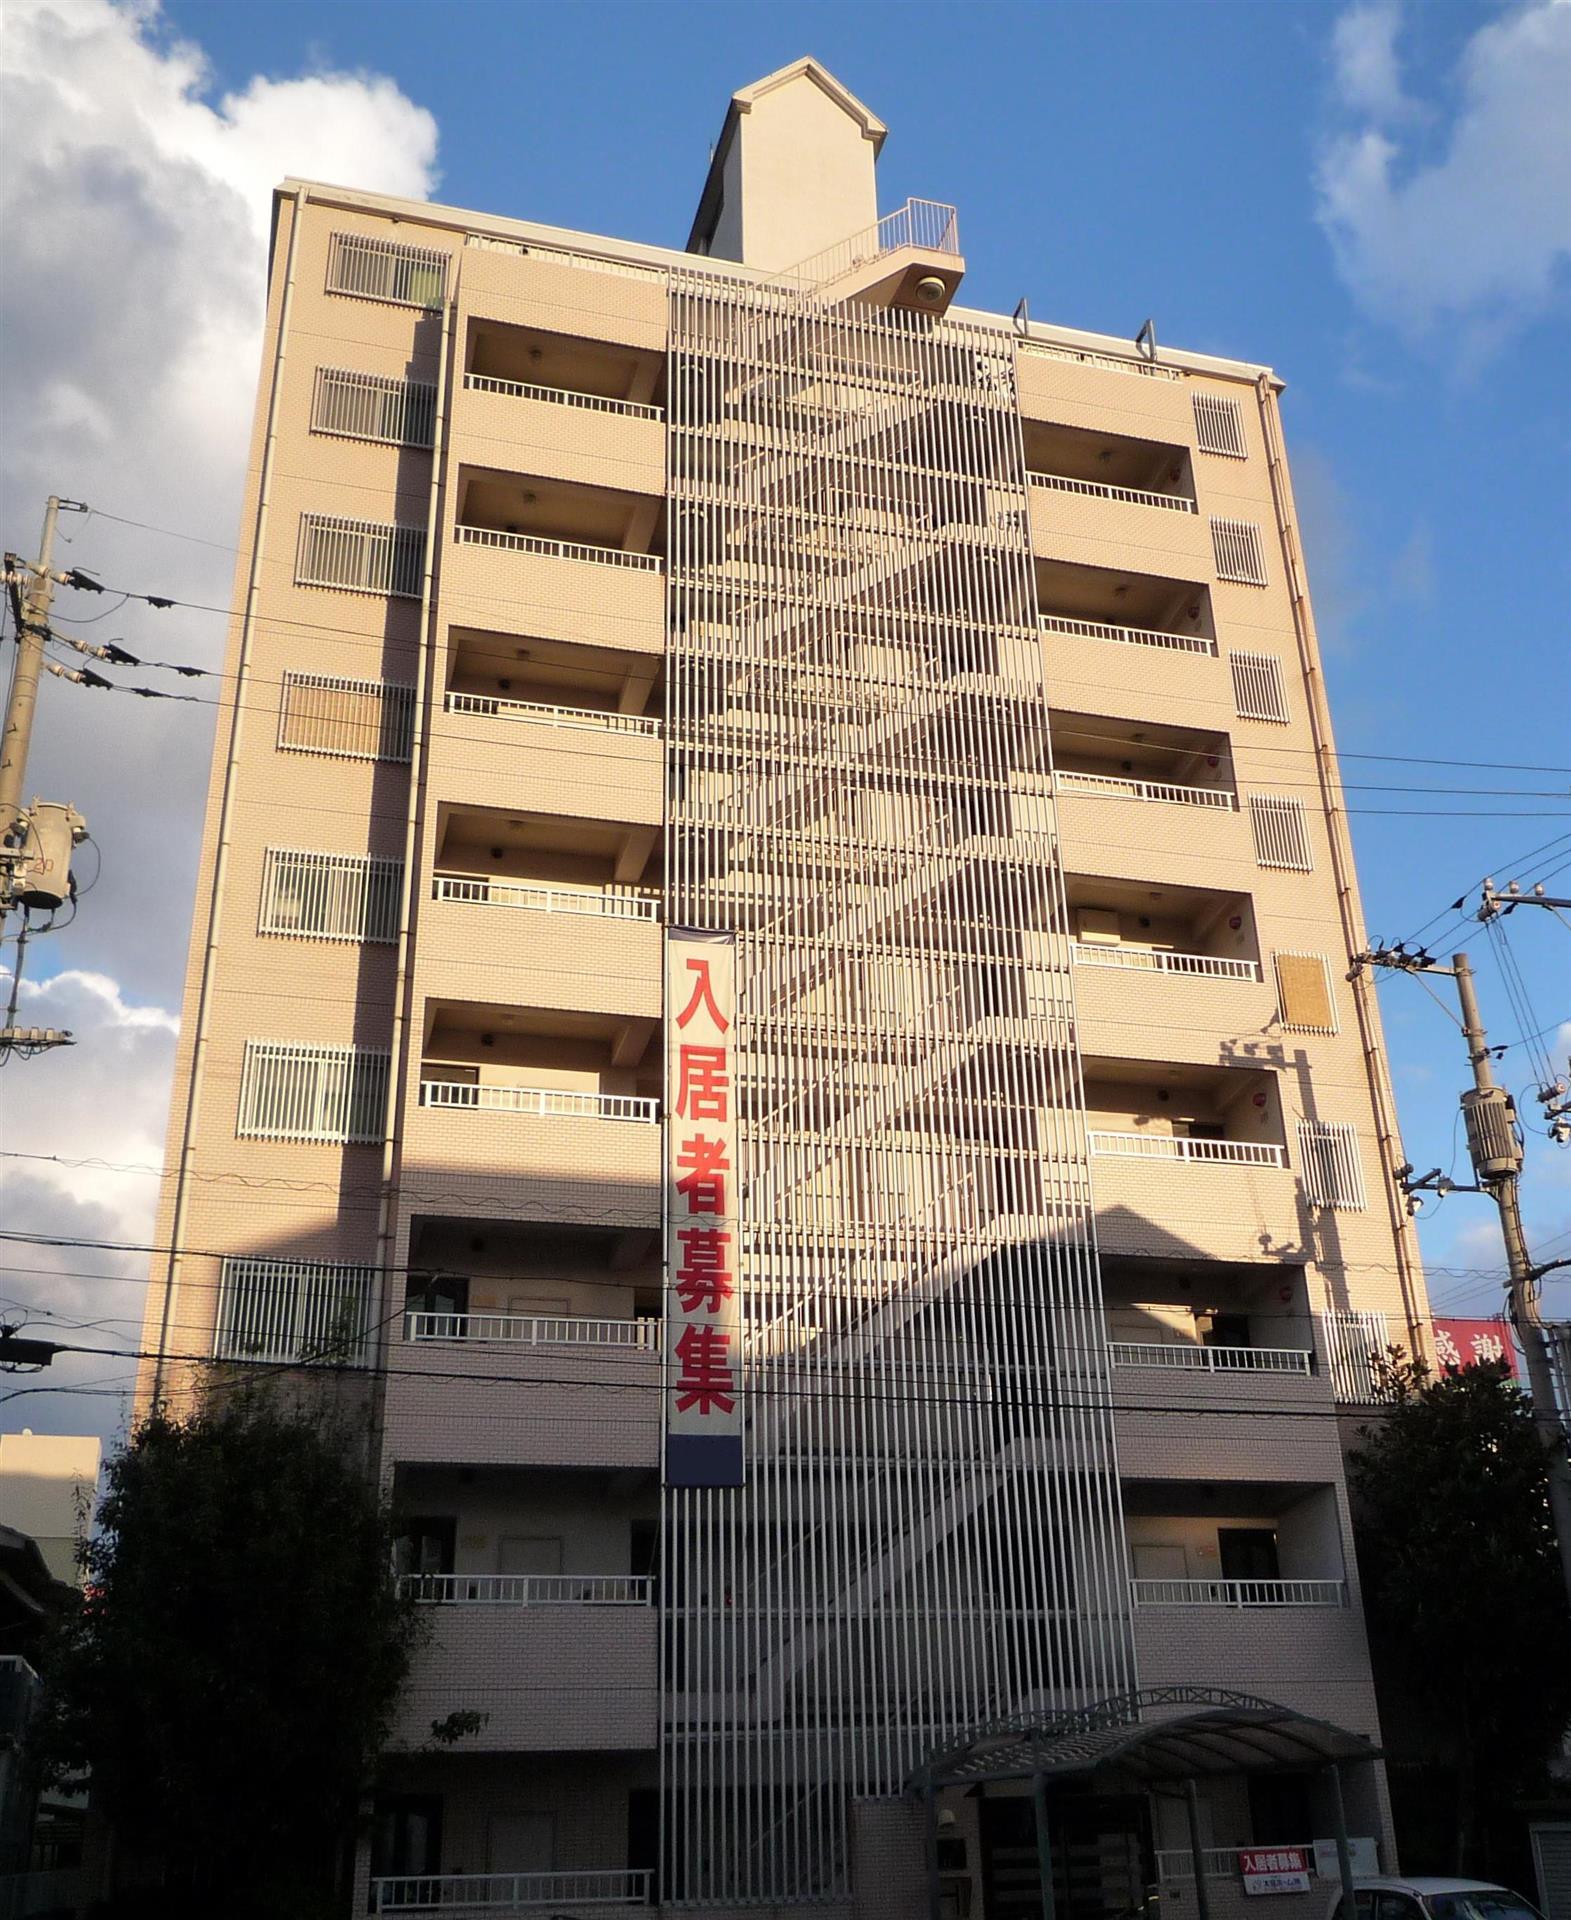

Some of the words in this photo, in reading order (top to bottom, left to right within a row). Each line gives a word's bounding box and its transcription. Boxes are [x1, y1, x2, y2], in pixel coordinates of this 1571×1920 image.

[675, 958, 735, 1415] 入居者募集
[1244, 1852, 1302, 1872] 入居者募集
